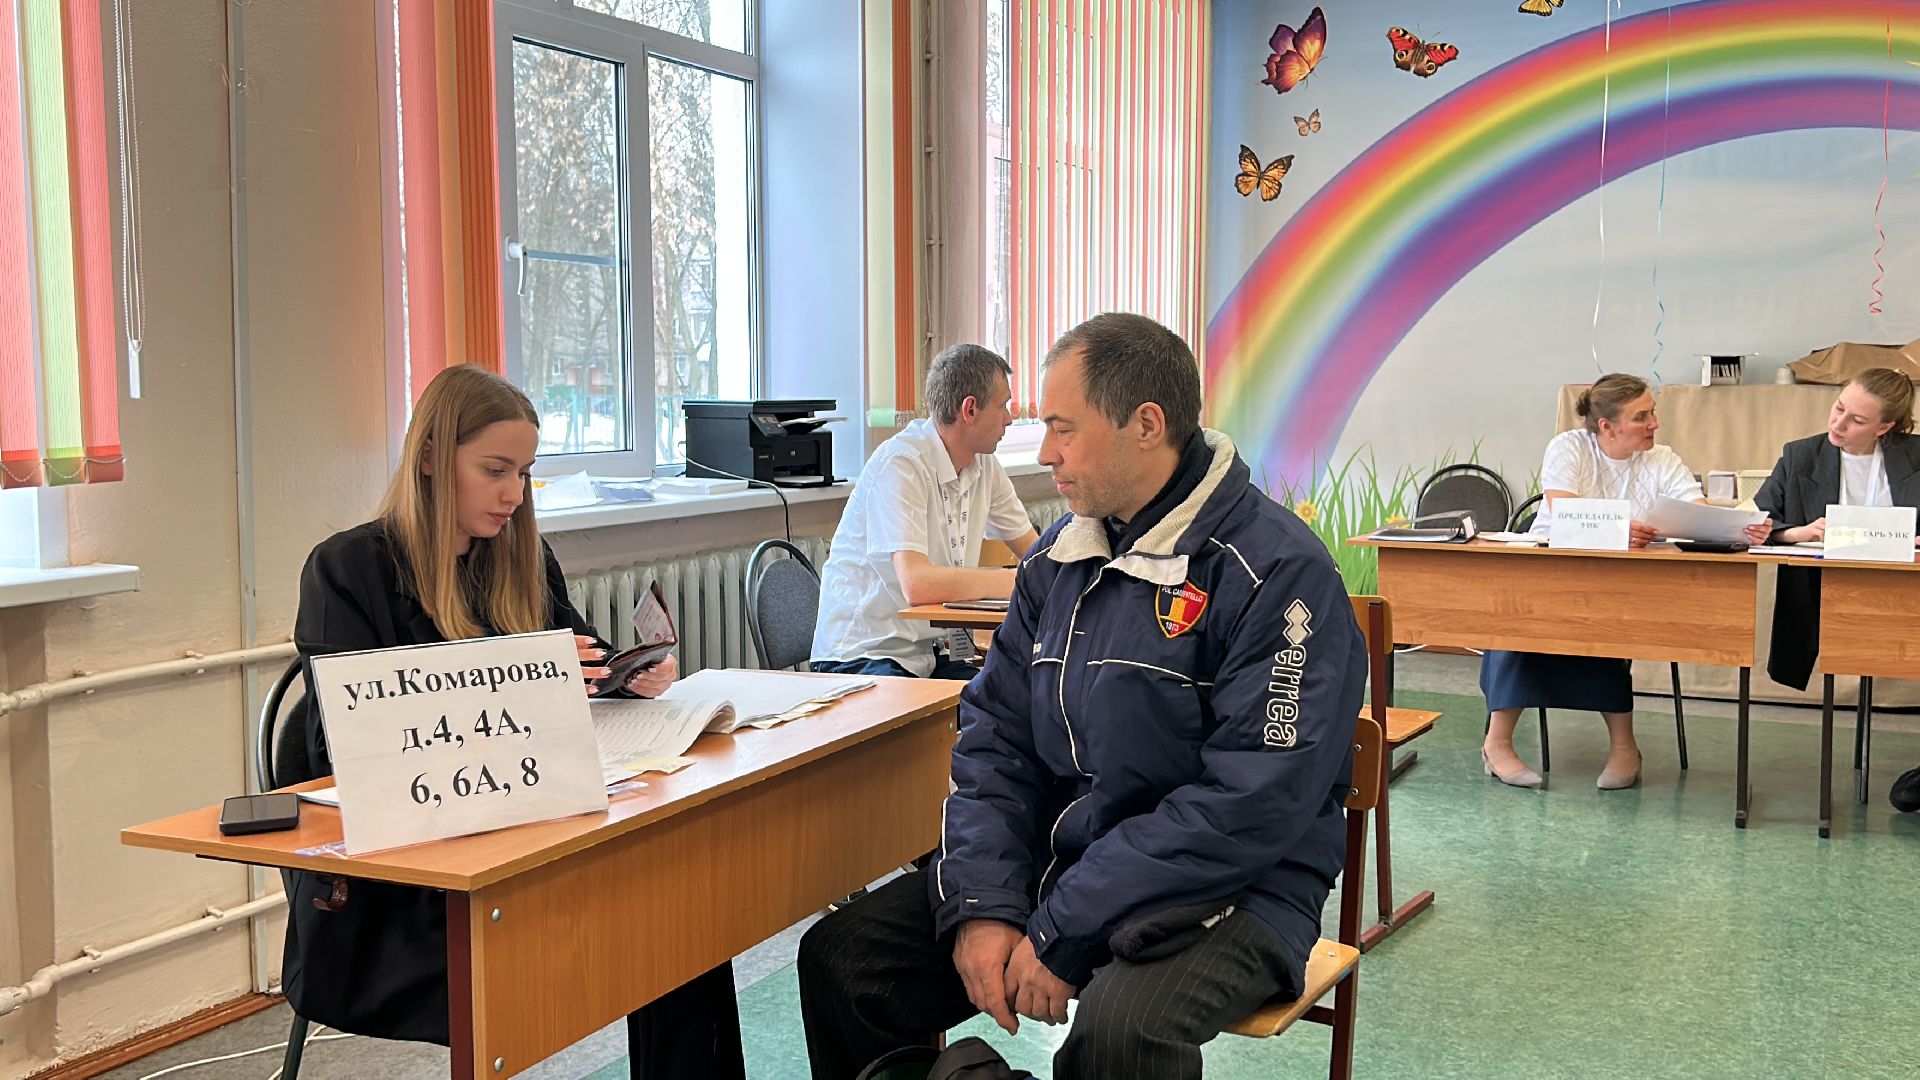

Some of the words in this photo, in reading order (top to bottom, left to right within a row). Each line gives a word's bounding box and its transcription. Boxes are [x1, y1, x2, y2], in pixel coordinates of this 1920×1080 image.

[1558, 512, 1624, 521] ПРЕДСЕДАТЕЛЬ
[1165, 621, 1180, 632] 1973
[342, 659, 570, 710] ул.Комарова,
[402, 714, 465, 754] д.4,
[473, 707, 533, 739] 4А,
[410, 772, 442, 808] 6,
[452, 763, 512, 796] 6А,
[519, 756, 541, 786] 8
